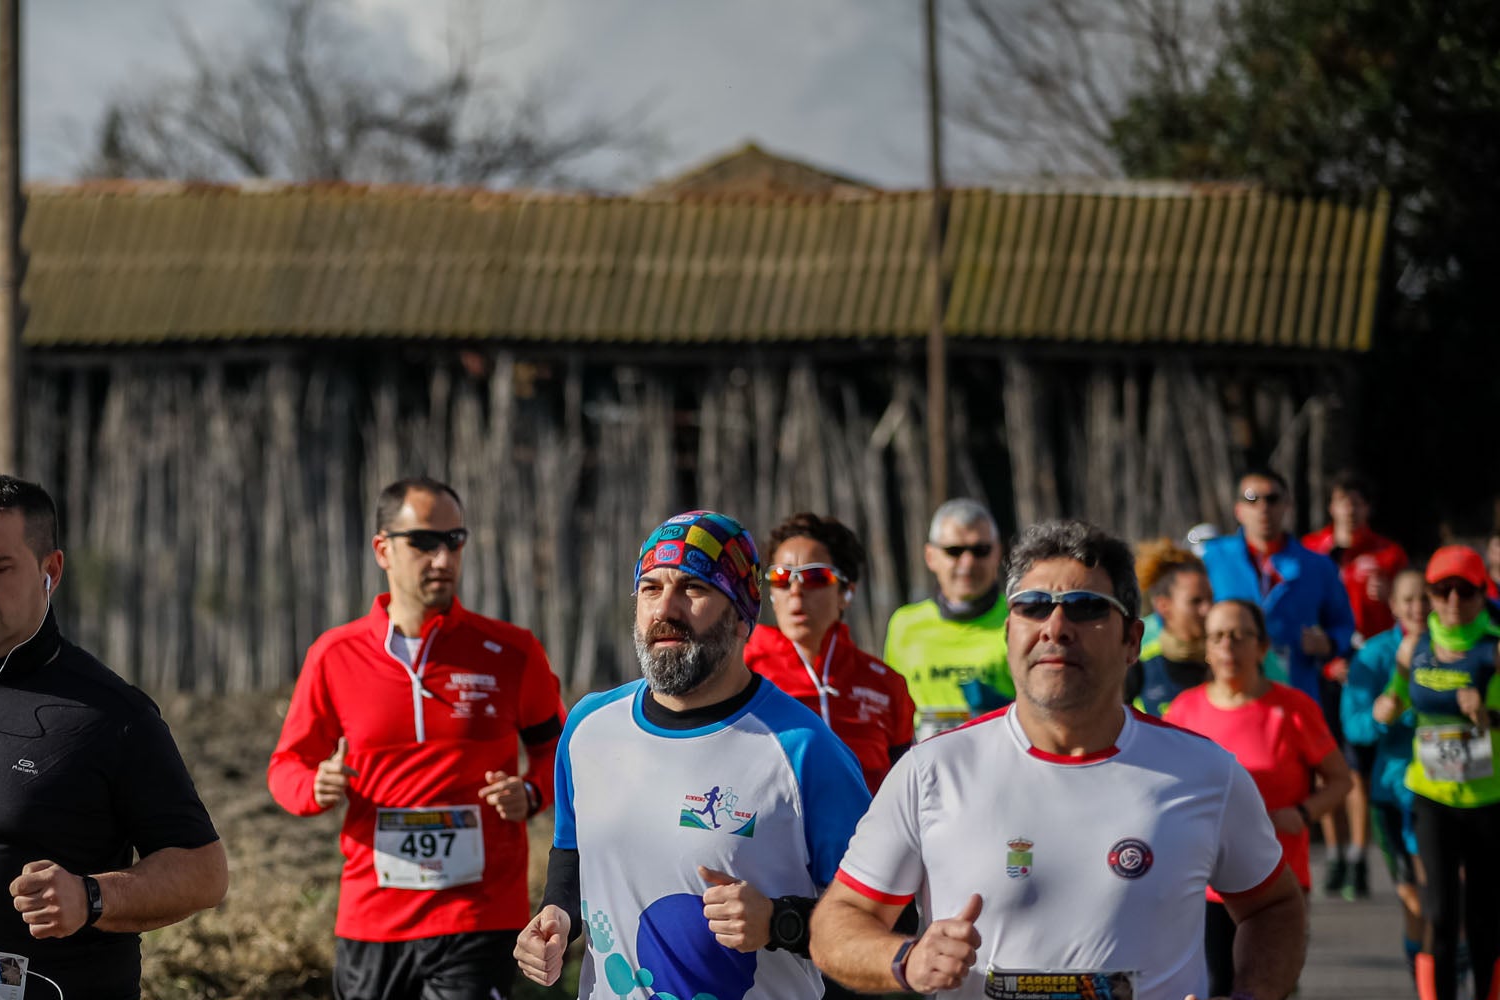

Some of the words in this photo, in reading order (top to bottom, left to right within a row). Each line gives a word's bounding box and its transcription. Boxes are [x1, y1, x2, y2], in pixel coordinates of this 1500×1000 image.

[400, 832, 456, 858] 497
[1017, 975, 1077, 985] CARRERA
[1017, 984, 1078, 993] POPULAR
